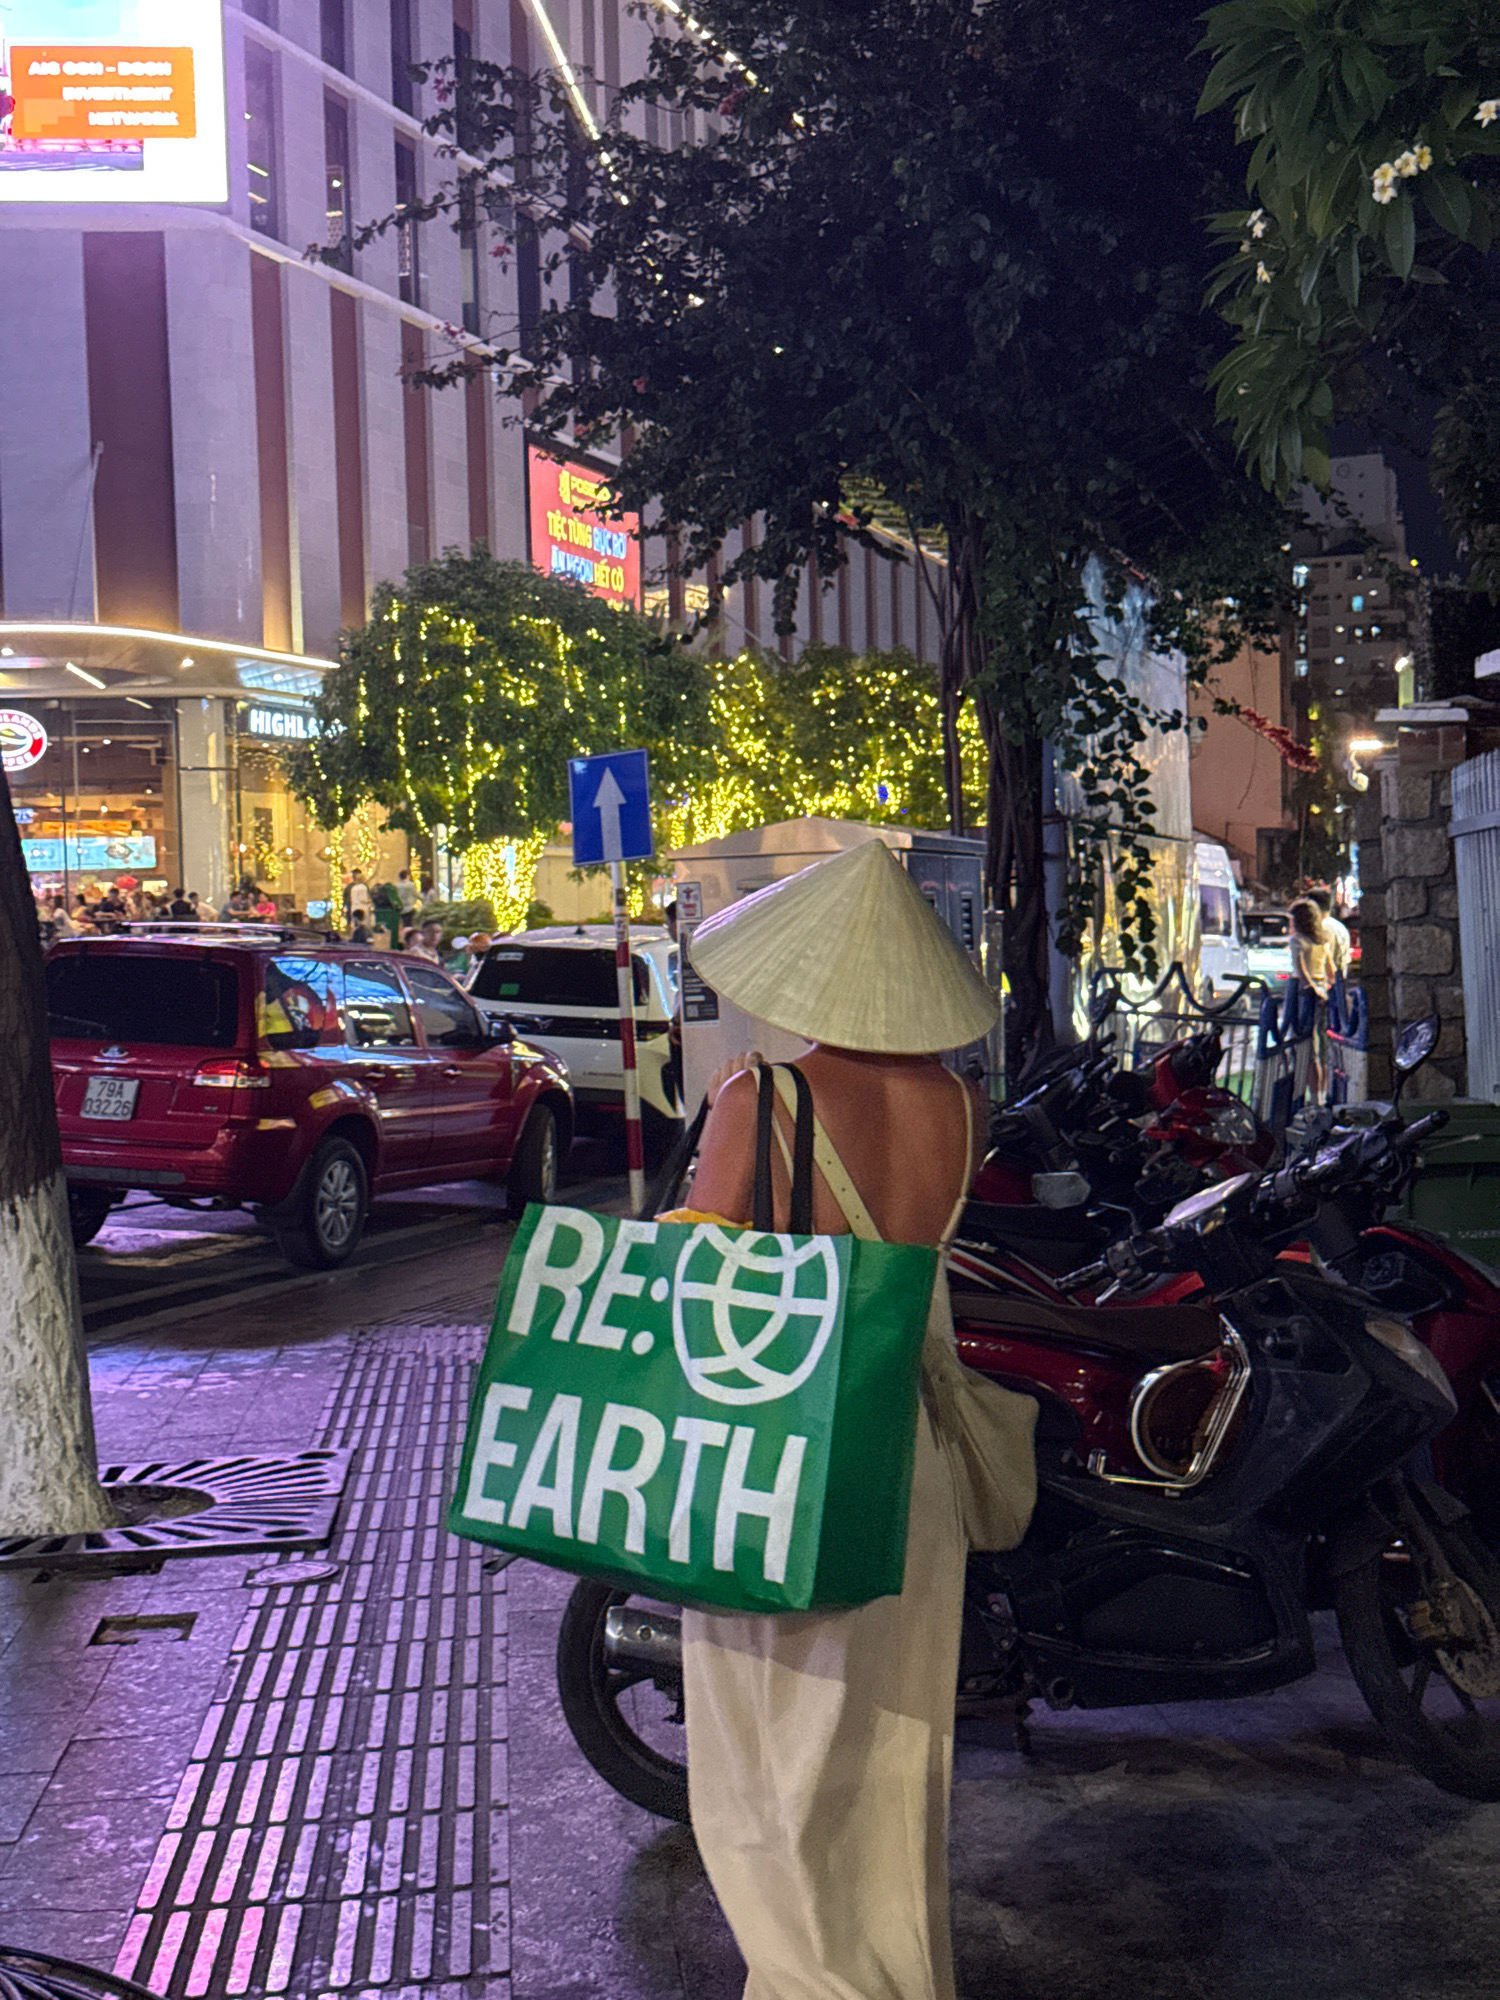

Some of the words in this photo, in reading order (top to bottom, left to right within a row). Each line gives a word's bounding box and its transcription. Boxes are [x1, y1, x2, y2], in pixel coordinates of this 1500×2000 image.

[97, 1081, 124, 1098] 79A
[507, 1205, 670, 1356] RE:
[461, 1382, 808, 1584] EARTH
